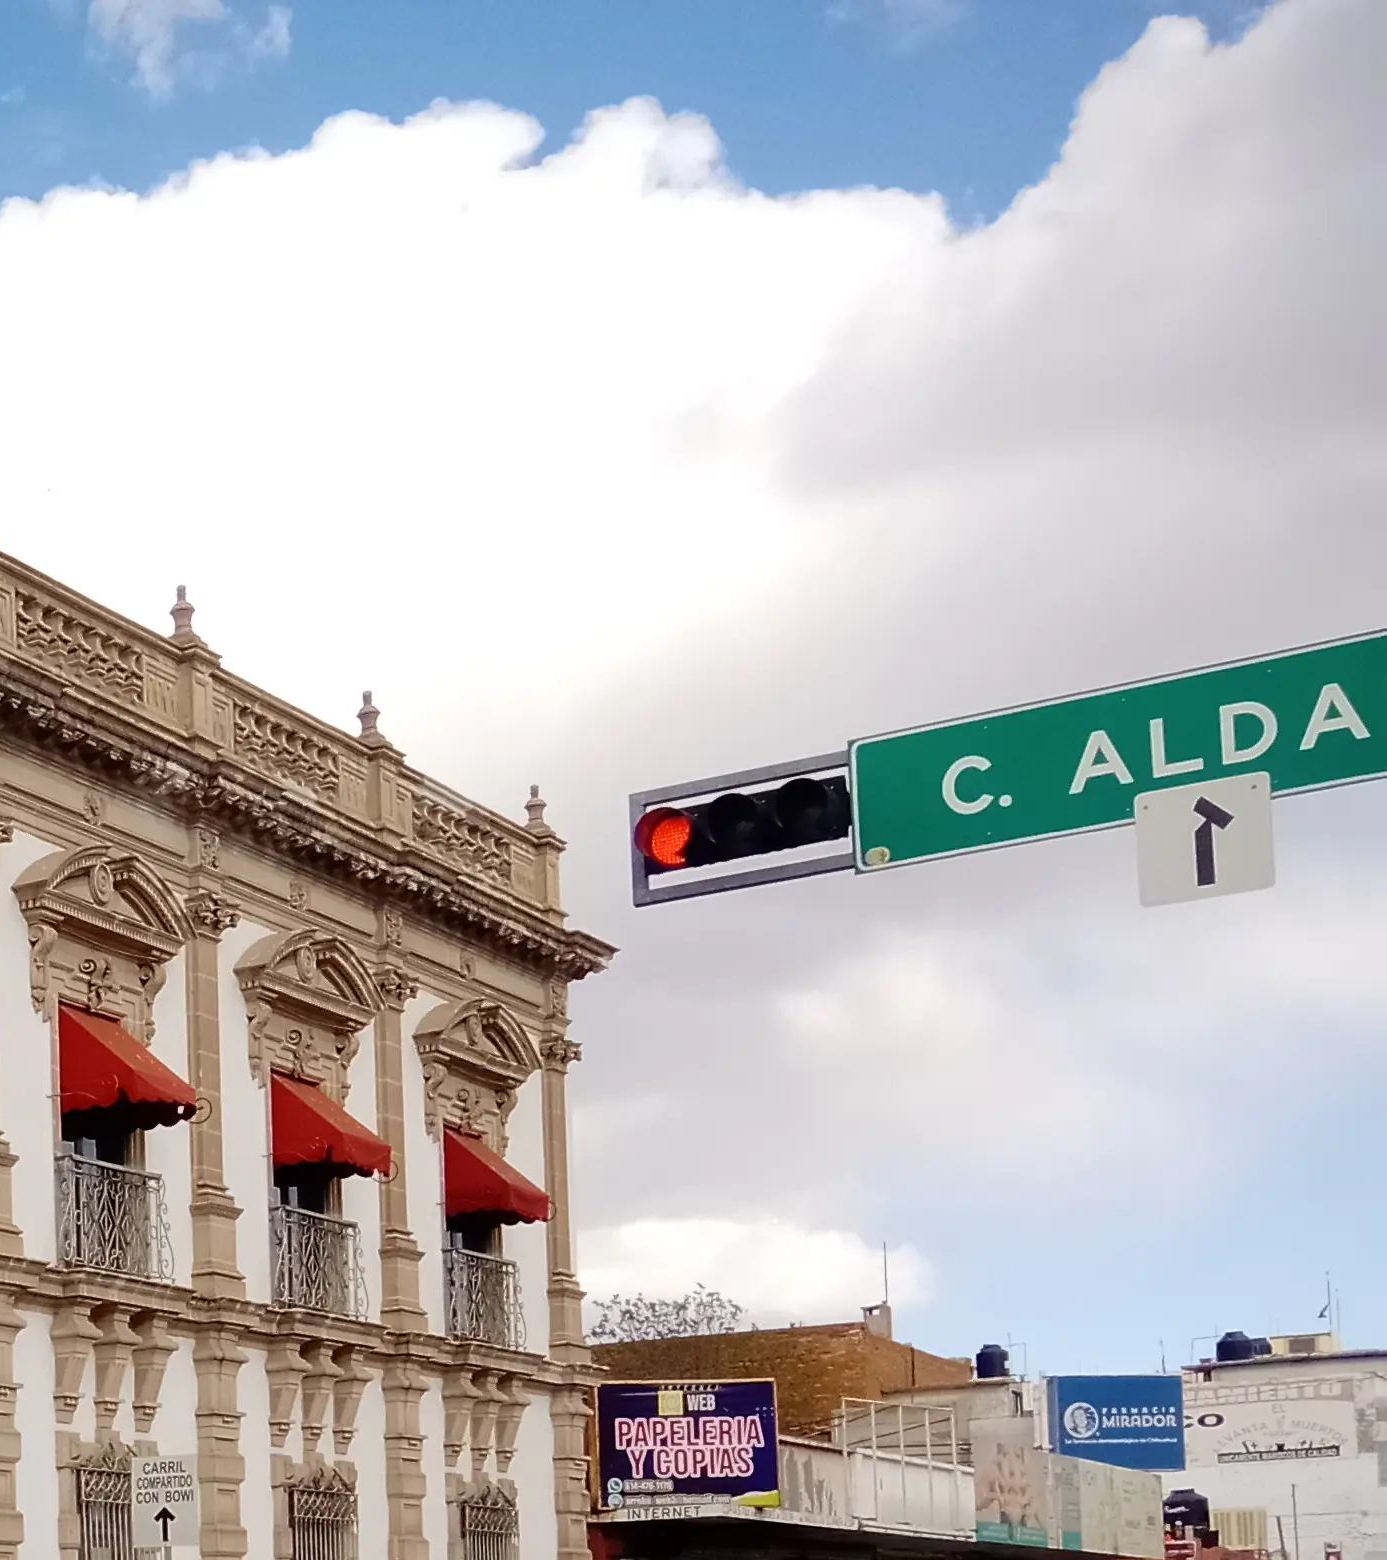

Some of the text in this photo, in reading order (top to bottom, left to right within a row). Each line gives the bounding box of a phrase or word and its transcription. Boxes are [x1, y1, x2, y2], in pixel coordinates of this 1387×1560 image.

[941, 682, 1370, 816] C. ALDA
[687, 1393, 716, 1411] WEB
[1102, 1406, 1176, 1415] FARMACIA
[1102, 1414, 1177, 1428] MIRADOR
[615, 1416, 764, 1450] PAPELERIA
[142, 1461, 186, 1475] CARRIL
[628, 1447, 755, 1479] Y COPIAS
[136, 1474, 193, 1490] COMPARTIDO
[135, 1490, 194, 1504] CON BOWI
[627, 1506, 701, 1519] INTERNET
